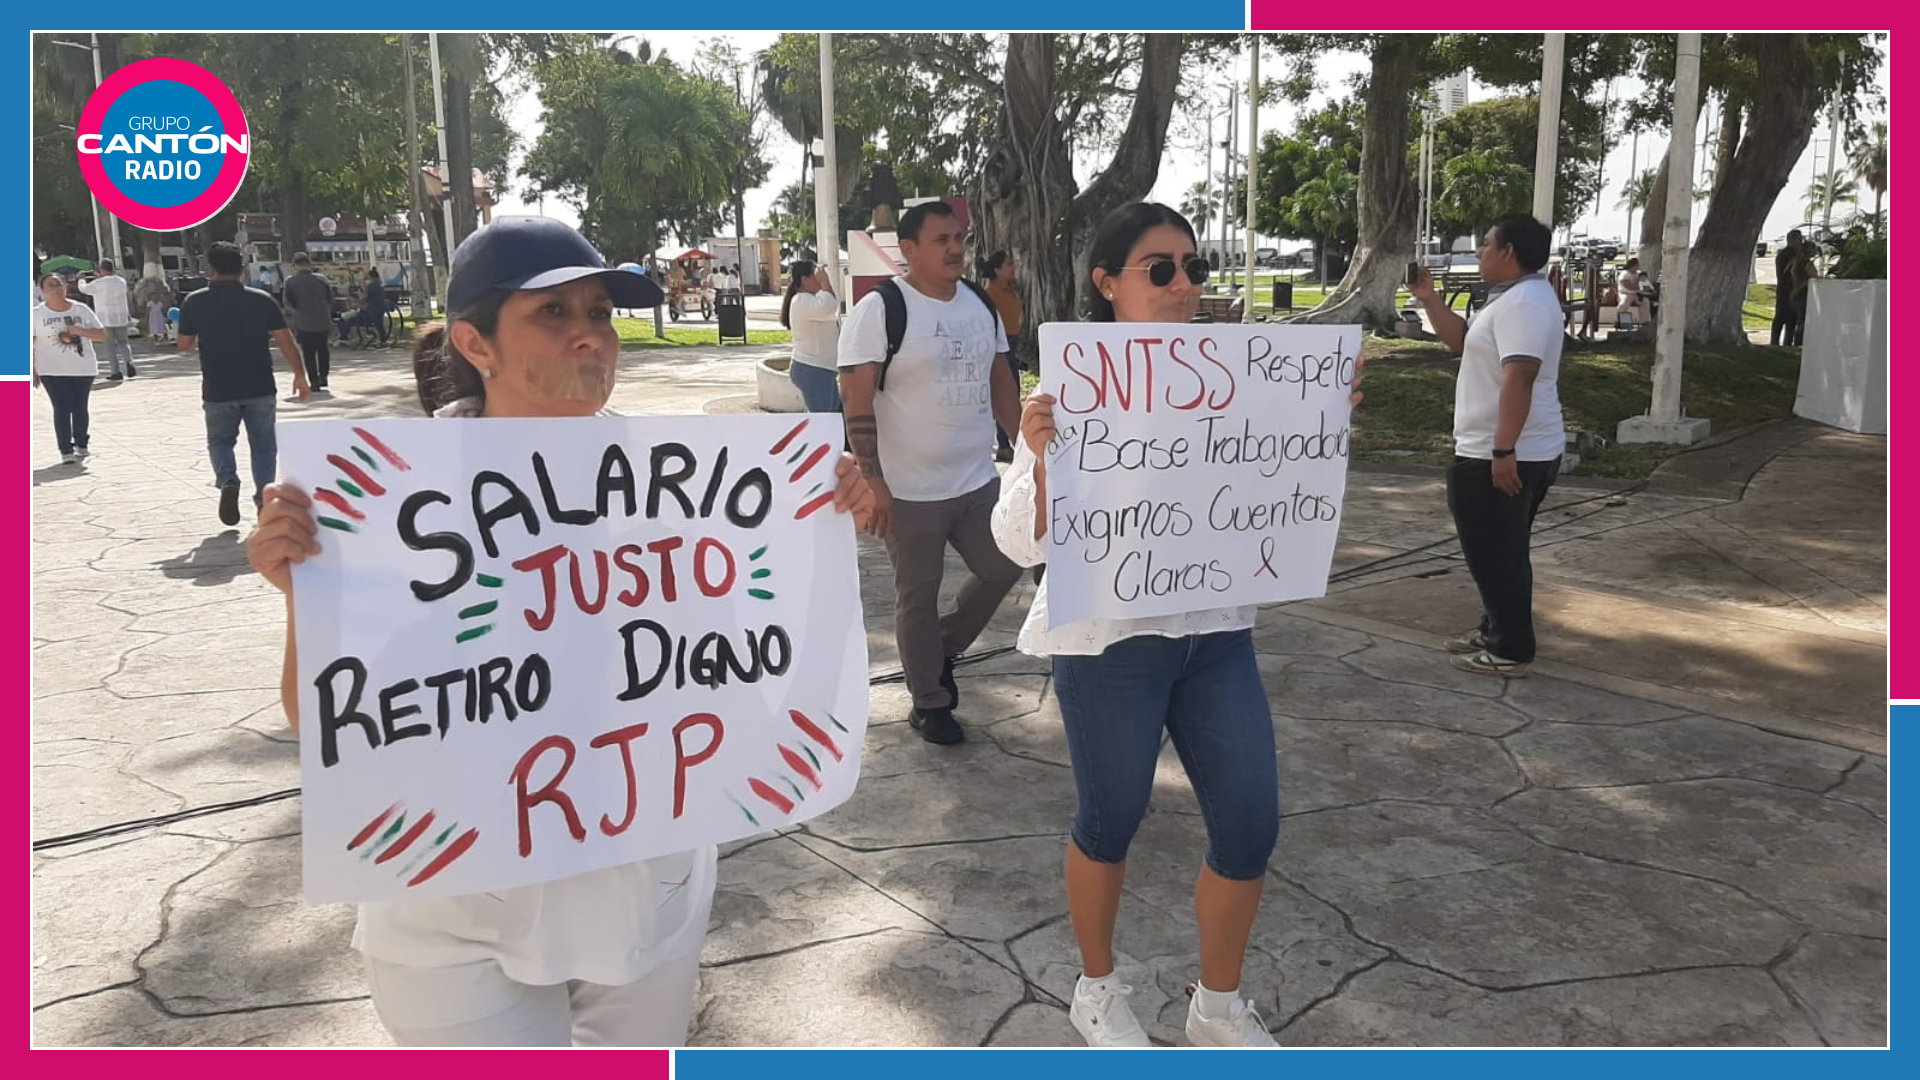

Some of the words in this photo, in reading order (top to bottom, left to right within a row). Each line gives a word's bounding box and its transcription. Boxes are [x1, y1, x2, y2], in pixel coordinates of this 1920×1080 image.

[1060, 338, 1236, 414] SNTSS
[1247, 335, 1355, 400] Respeto
[1078, 418, 1189, 473] Base
[397, 443, 773, 602] SALARIO
[1052, 495, 1193, 564] Exigimos
[1207, 483, 1337, 532] Cuentas
[511, 535, 736, 632] JUSTO
[1114, 550, 1232, 602] Claras
[313, 652, 551, 768] RETIRO
[617, 618, 792, 701] DIGNO
[508, 712, 725, 858] RJP
